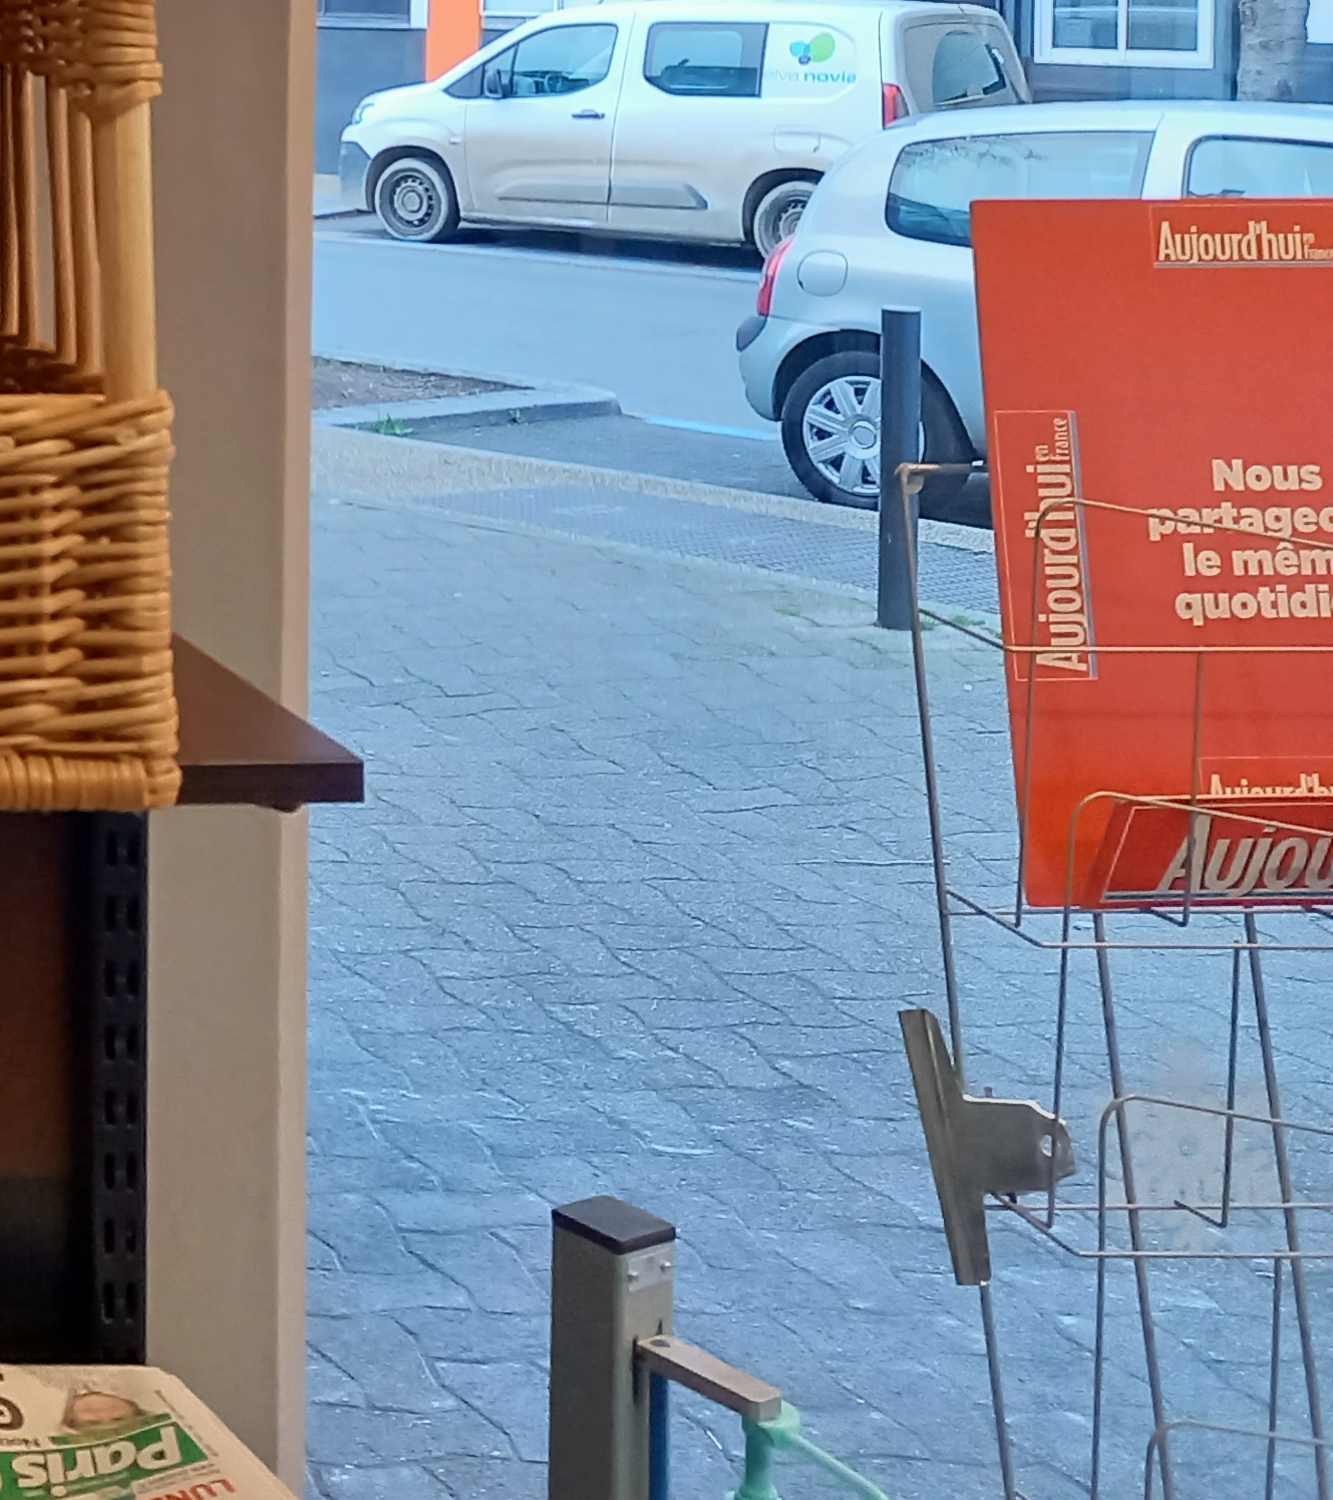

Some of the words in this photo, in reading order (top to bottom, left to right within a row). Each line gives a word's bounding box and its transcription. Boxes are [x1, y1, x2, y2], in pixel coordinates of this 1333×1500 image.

[804, 70, 857, 83] novia
[1158, 220, 1302, 263] Aujourd'hui
[1212, 458, 1323, 491] Nous
[1024, 464, 1088, 672] Aujourd'hui
[1182, 542, 1222, 577] le
[1231, 541, 1333, 577] mêm
[1175, 583, 1333, 627] quotidi
[11, 1426, 182, 1498] Paris
[150, 1478, 238, 1500] LUN
